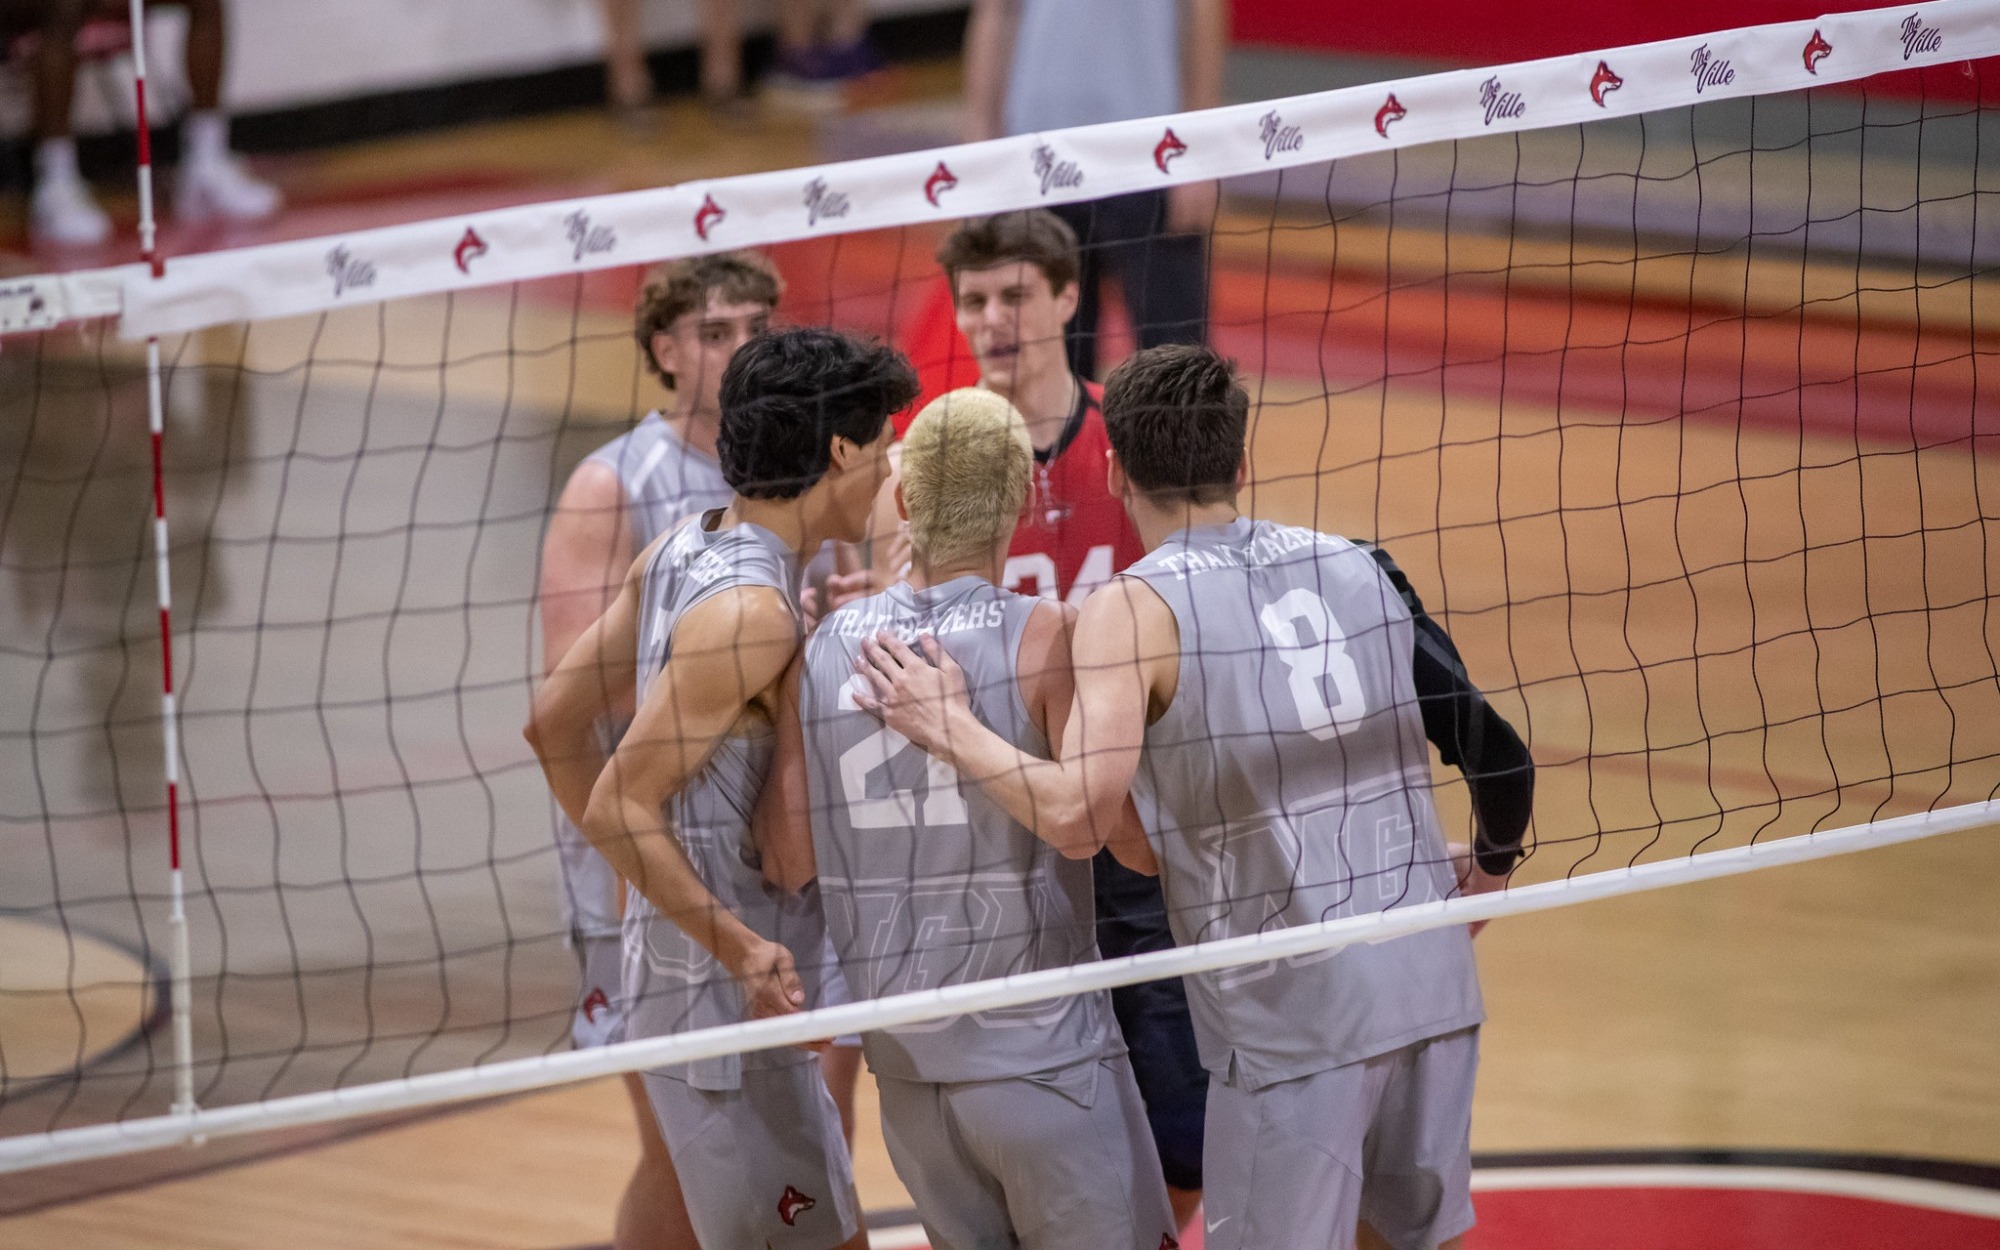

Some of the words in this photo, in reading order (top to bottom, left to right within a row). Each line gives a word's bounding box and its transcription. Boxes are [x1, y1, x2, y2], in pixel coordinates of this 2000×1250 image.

[1900, 11, 1922, 41] The
[1690, 43, 1712, 73] The
[1903, 27, 1942, 61] Ville
[1480, 74, 1501, 105] The
[1694, 60, 1735, 94] Ville
[1483, 92, 1526, 126] Ville
[1262, 126, 1304, 160] Ville
[1260, 587, 1367, 742] 8
